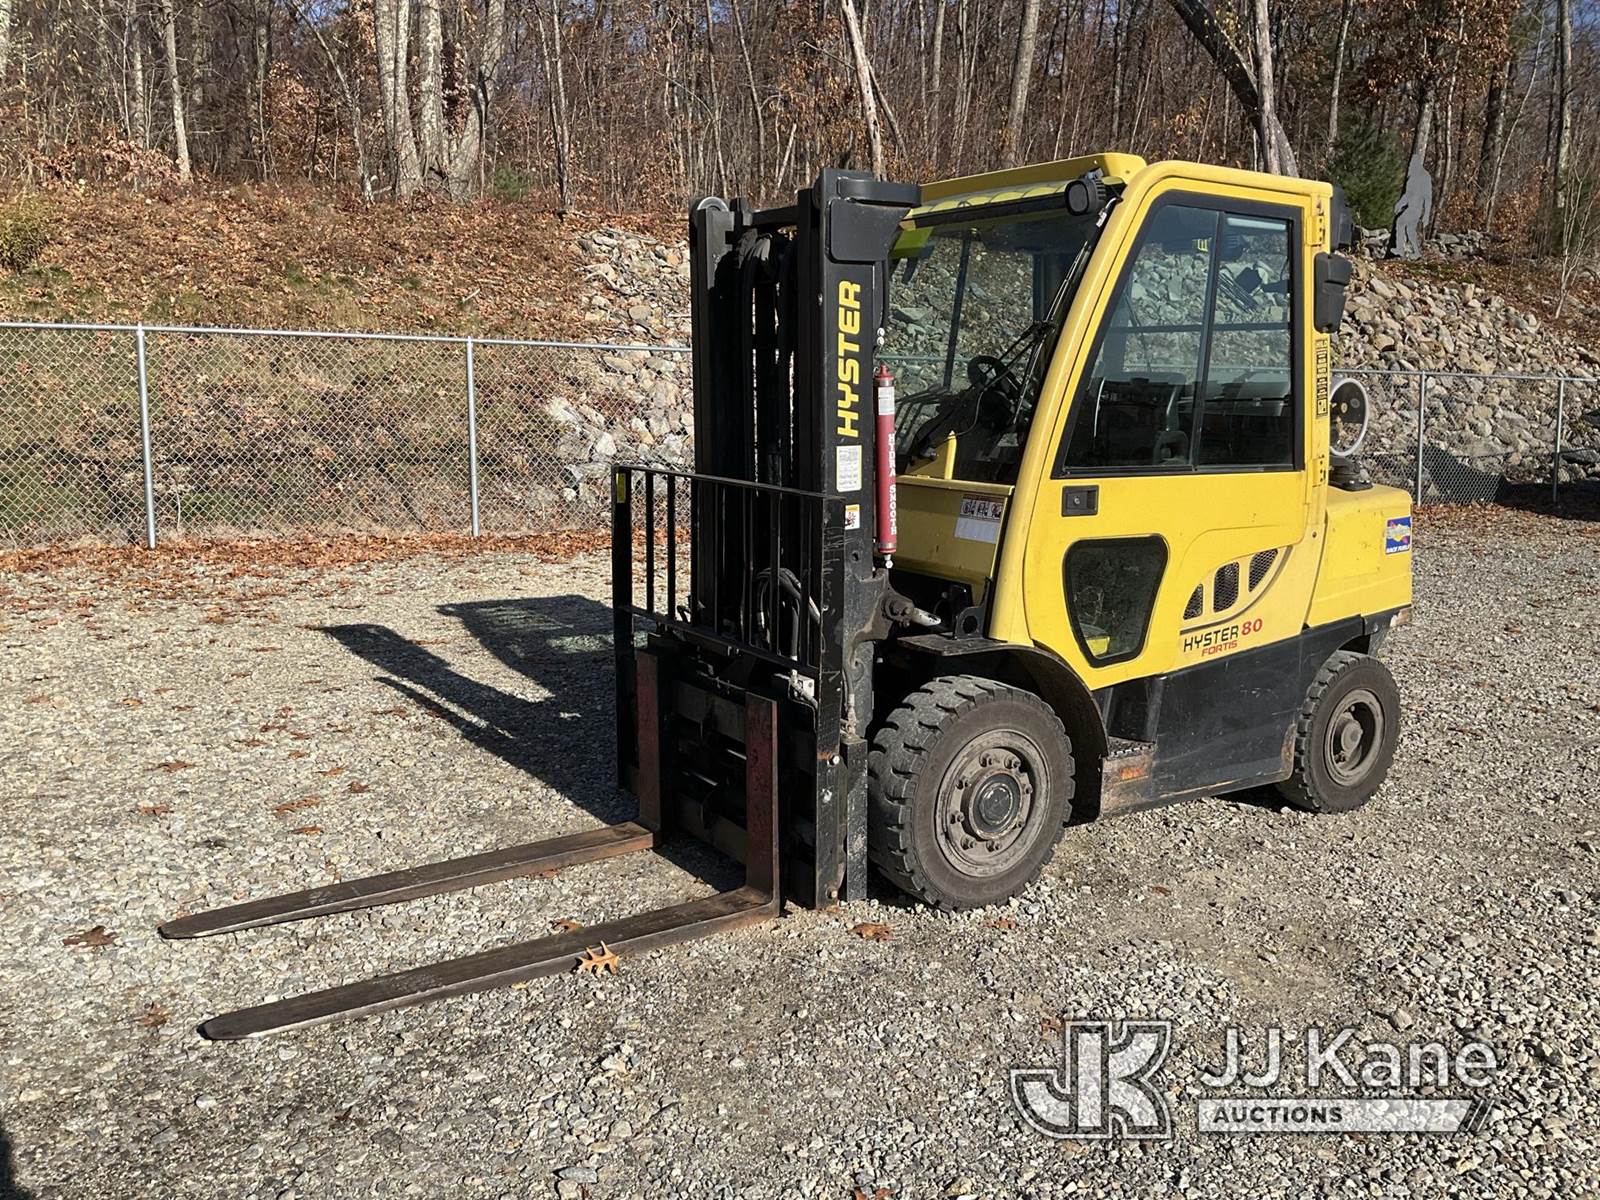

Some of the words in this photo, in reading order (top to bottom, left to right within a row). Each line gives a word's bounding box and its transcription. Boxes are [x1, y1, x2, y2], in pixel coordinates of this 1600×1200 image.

[837, 280, 862, 438] HYSTER
[1183, 625, 1239, 652] HYSTER
[1241, 618, 1263, 635] 80
[1201, 640, 1238, 657] FORTIS
